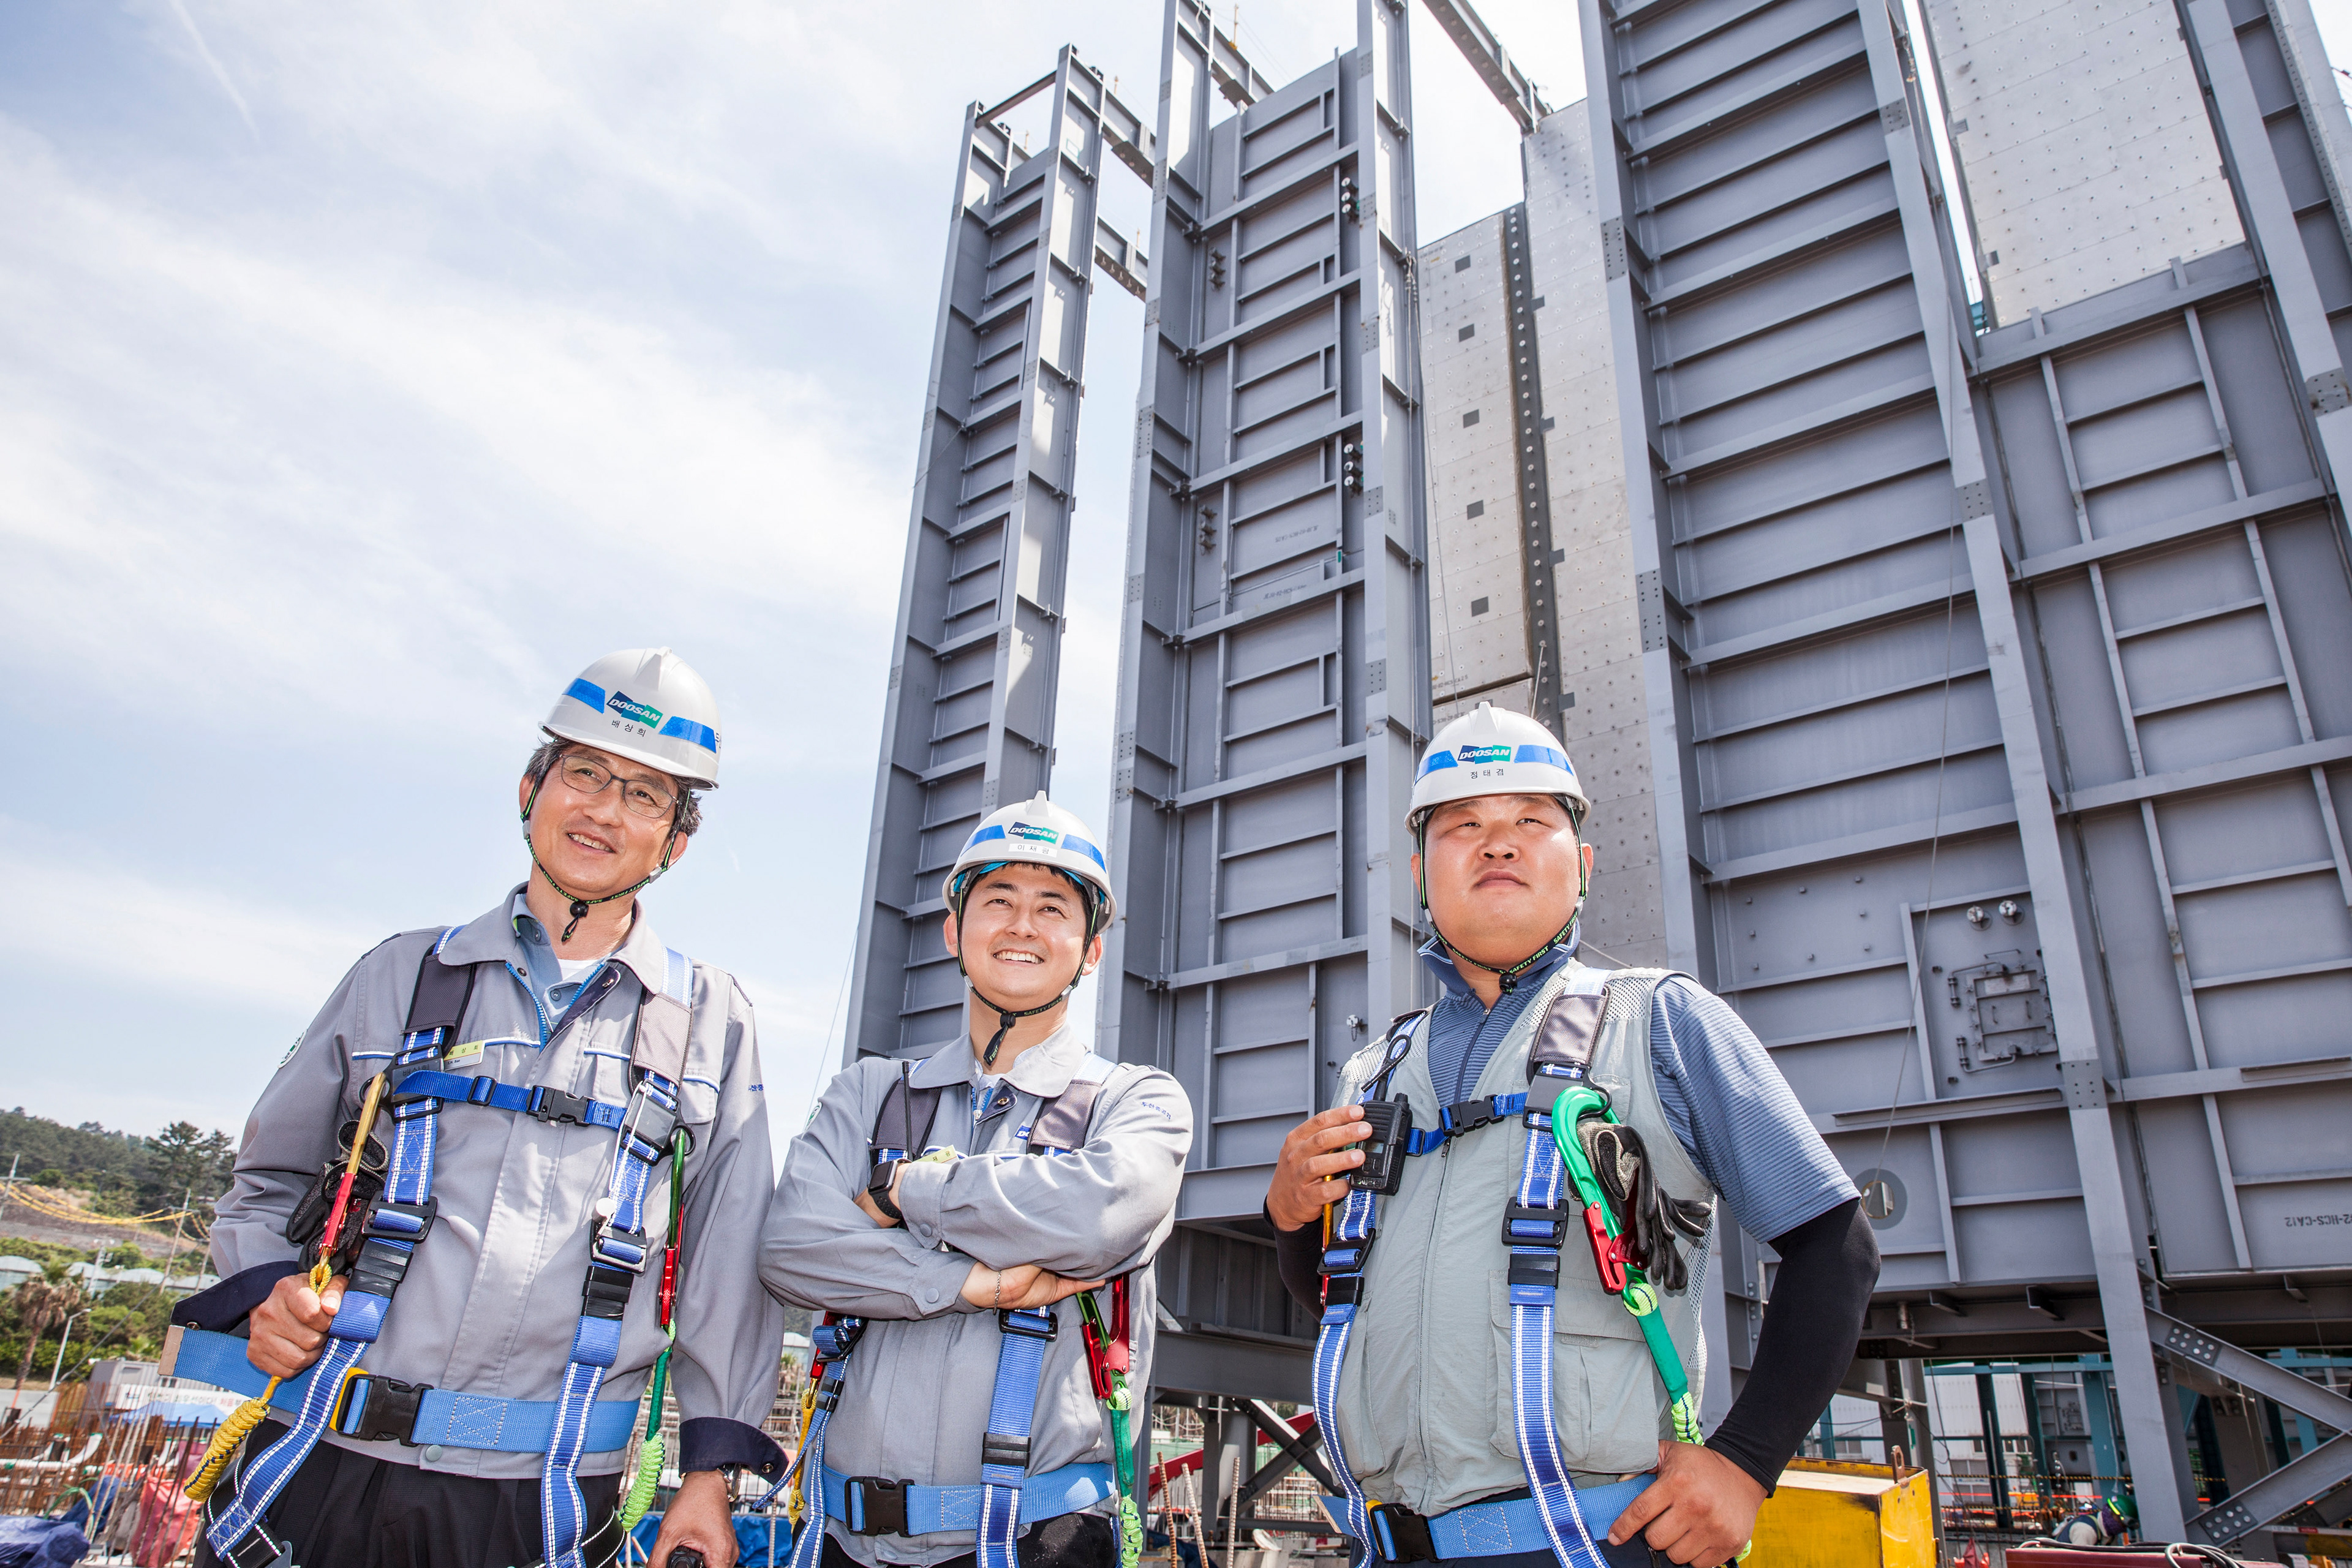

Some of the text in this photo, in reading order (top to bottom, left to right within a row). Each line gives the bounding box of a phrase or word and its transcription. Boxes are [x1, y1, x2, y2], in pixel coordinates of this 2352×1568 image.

[609, 698, 661, 722] DOOSAN
[1460, 748, 1510, 760] DOOSAN
[1010, 827, 1058, 840] DOOSAN
[1553, 924, 1570, 944] SAFETY
[1508, 945, 1549, 974] SAFETY FIRST
[1023, 1005, 1047, 1016] SAFETY
[989, 1045, 999, 1061] FIRST
